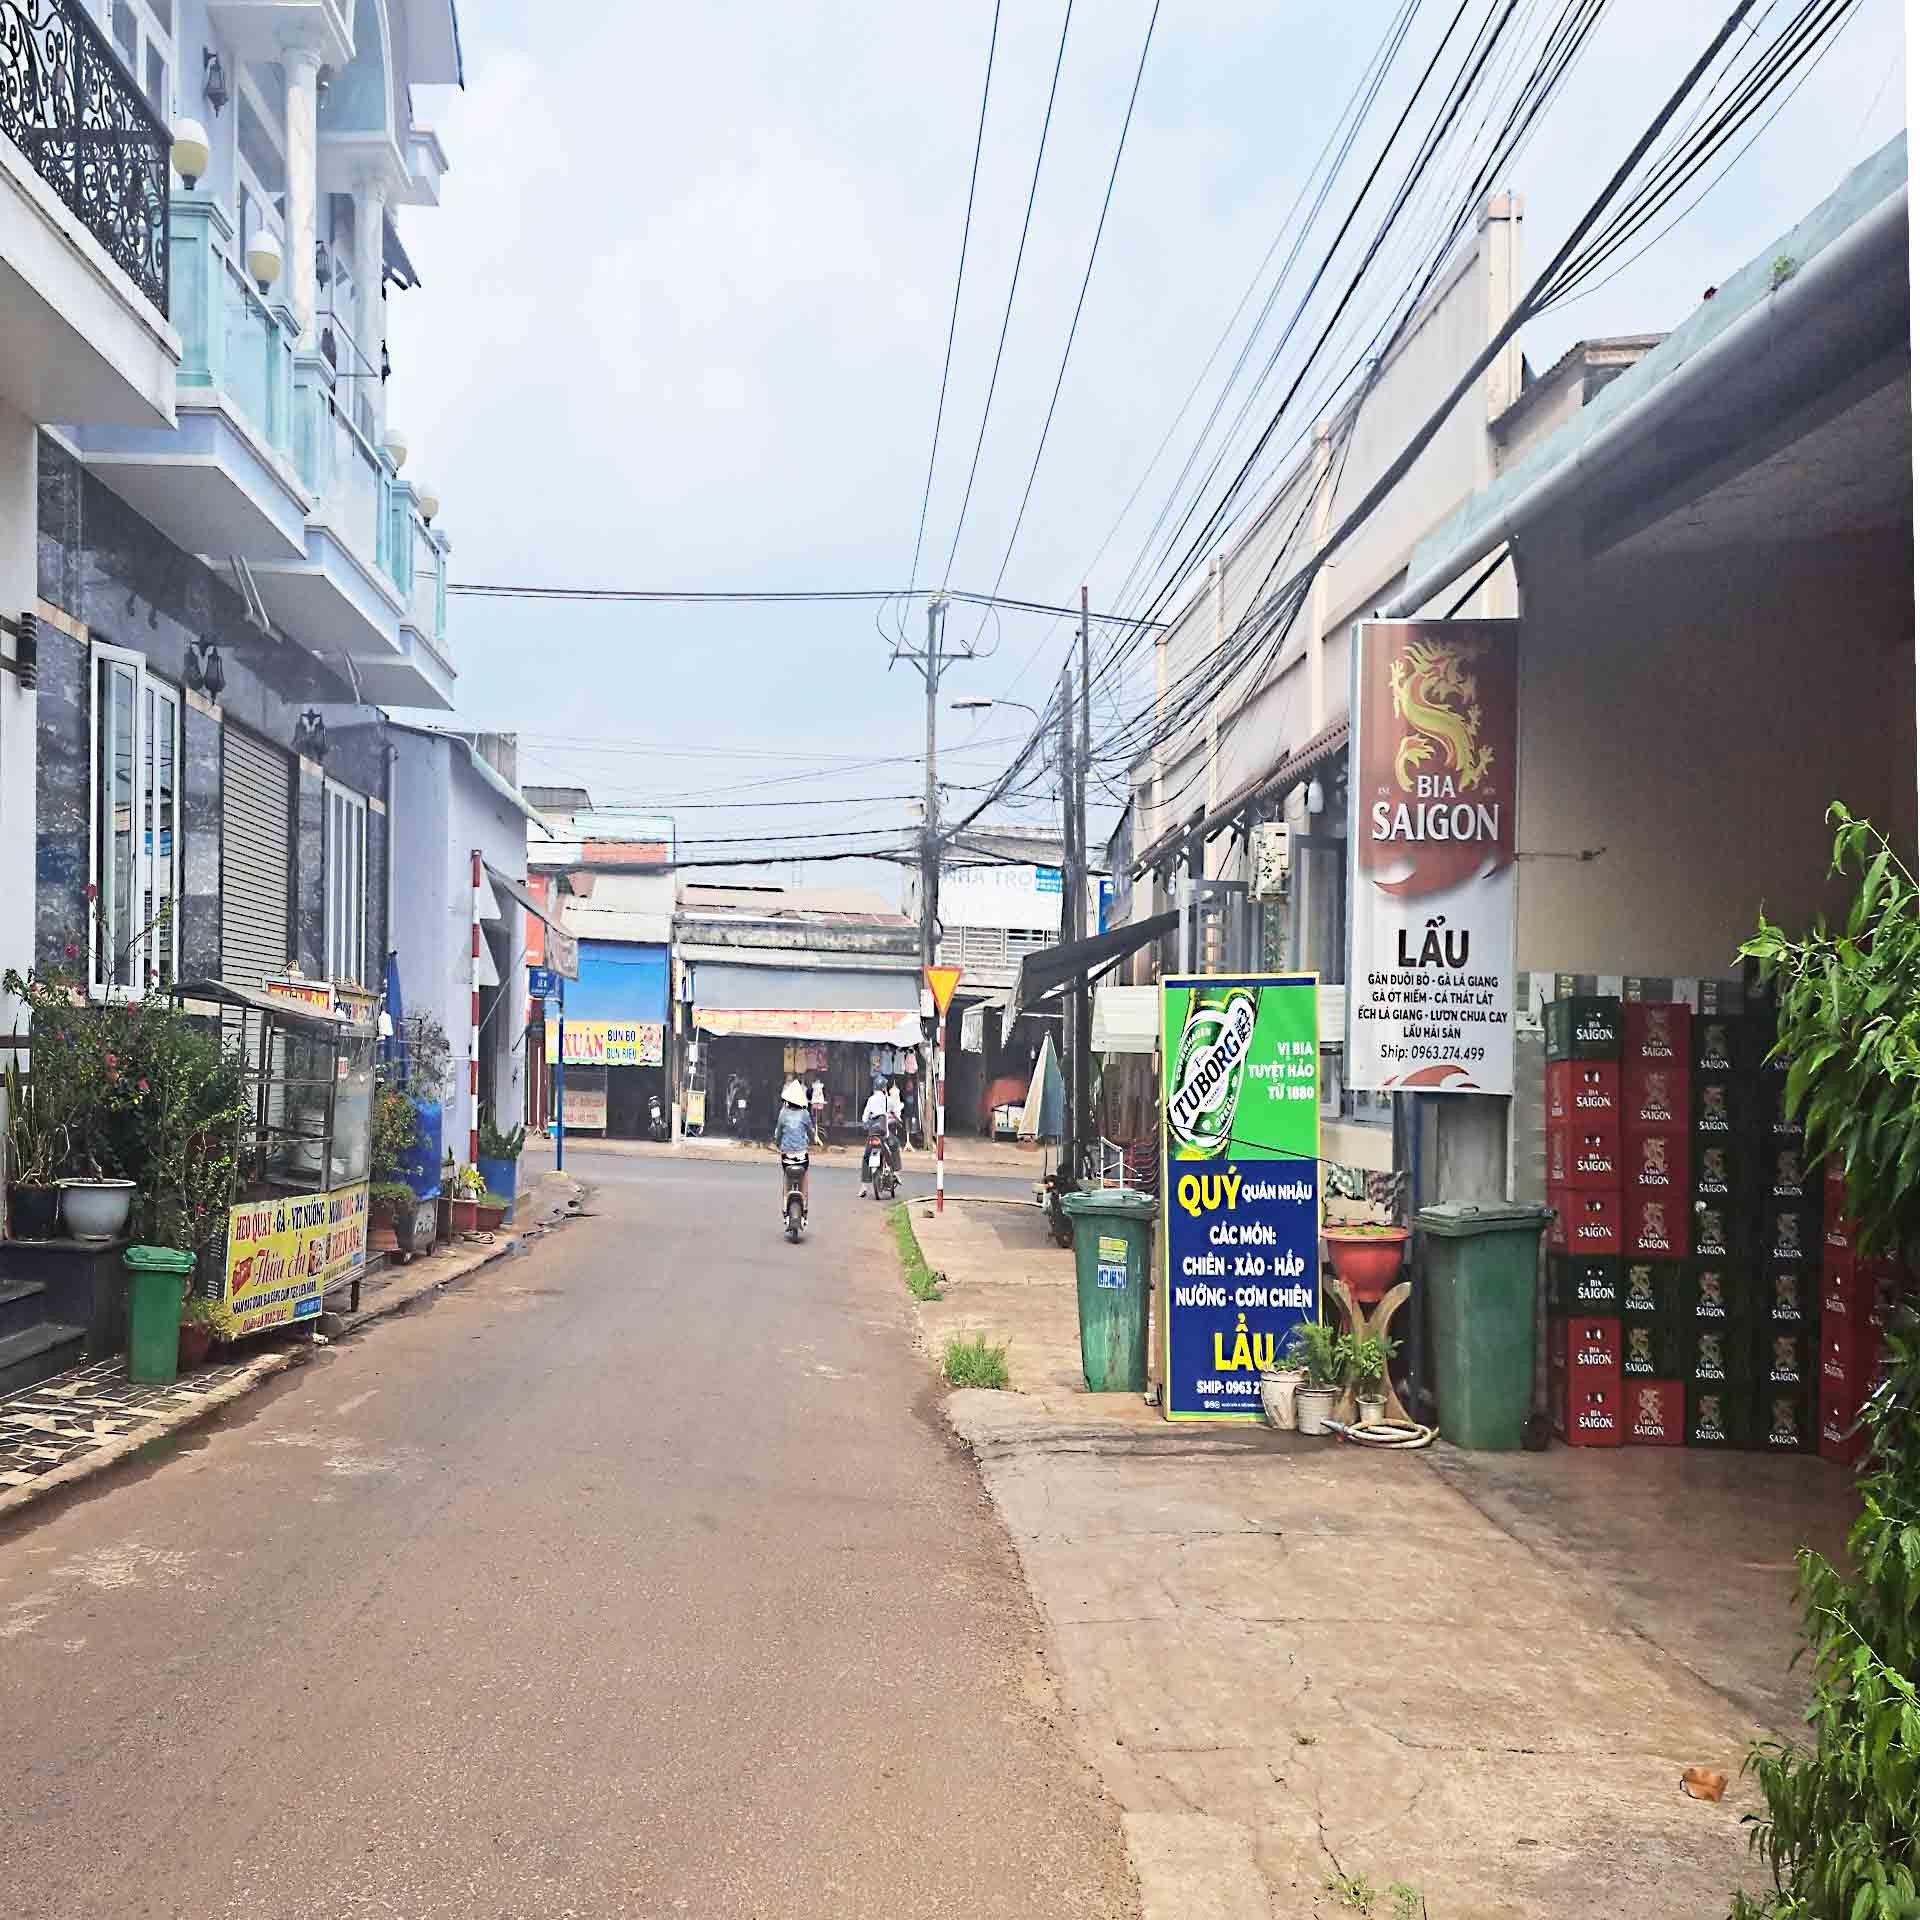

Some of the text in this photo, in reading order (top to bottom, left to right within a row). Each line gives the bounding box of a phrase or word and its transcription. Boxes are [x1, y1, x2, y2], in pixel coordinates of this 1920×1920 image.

[1416, 774, 1457, 798] BIA
[1371, 801, 1499, 841] SAIGON
[1398, 915, 1470, 969] LẨU
[1467, 975, 1499, 988] GIANG
[1392, 1009, 1423, 1021] GIANG
[1460, 1010, 1487, 1022] CHUA
[1489, 1011, 1508, 1023] CAY
[1576, 1028, 1615, 1040] SAIGON
[1277, 1041, 1314, 1061] VỊ BIA
[1380, 1044, 1485, 1061] Ship: 0963.274.499
[1641, 1046, 1673, 1057] SAIGON
[1173, 1029, 1242, 1125] TUBORG
[1248, 1059, 1314, 1083] TUYỆT HẢO
[1576, 1096, 1612, 1107] SAIGON
[1640, 1110, 1671, 1120] SAIGON
[1577, 1160, 1612, 1171] SAIGON
[1639, 1174, 1670, 1185] SAIGON
[1177, 1165, 1312, 1217] QUÝ QUÁN NHẬU
[1699, 1183, 1728, 1193] SAIGON
[235, 1215, 250, 1241] HEO
[251, 1210, 273, 1244] QUAY
[1209, 1220, 1277, 1245] CÁC MÓN:
[1578, 1226, 1612, 1238] SAIGON
[1638, 1238, 1670, 1249] SAIGON
[1182, 1251, 1225, 1276] CHIÊN
[1234, 1251, 1265, 1276] XÀO
[1274, 1248, 1305, 1276] HẤP
[1175, 1282, 1227, 1307] NƯỚNG
[1235, 1284, 1268, 1307] CƠM
[1269, 1283, 1312, 1308] CHIÊN
[1577, 1286, 1615, 1299] SAIGON
[1625, 1299, 1656, 1311] SAIGON
[1696, 1307, 1725, 1317] SAIGON
[1772, 1309, 1801, 1320] SAIGON
[1214, 1312, 1275, 1371] LẨU
[1577, 1353, 1612, 1365] SAIGON
[1695, 1368, 1725, 1380] SAIGON
[1770, 1371, 1801, 1383] SAIGON
[1196, 1379, 1263, 1395] SHIP: 0963 2
[1579, 1416, 1615, 1428] SAIGON
[1633, 1424, 1665, 1436] SAIGON
[1695, 1429, 1725, 1440] SAIGON
